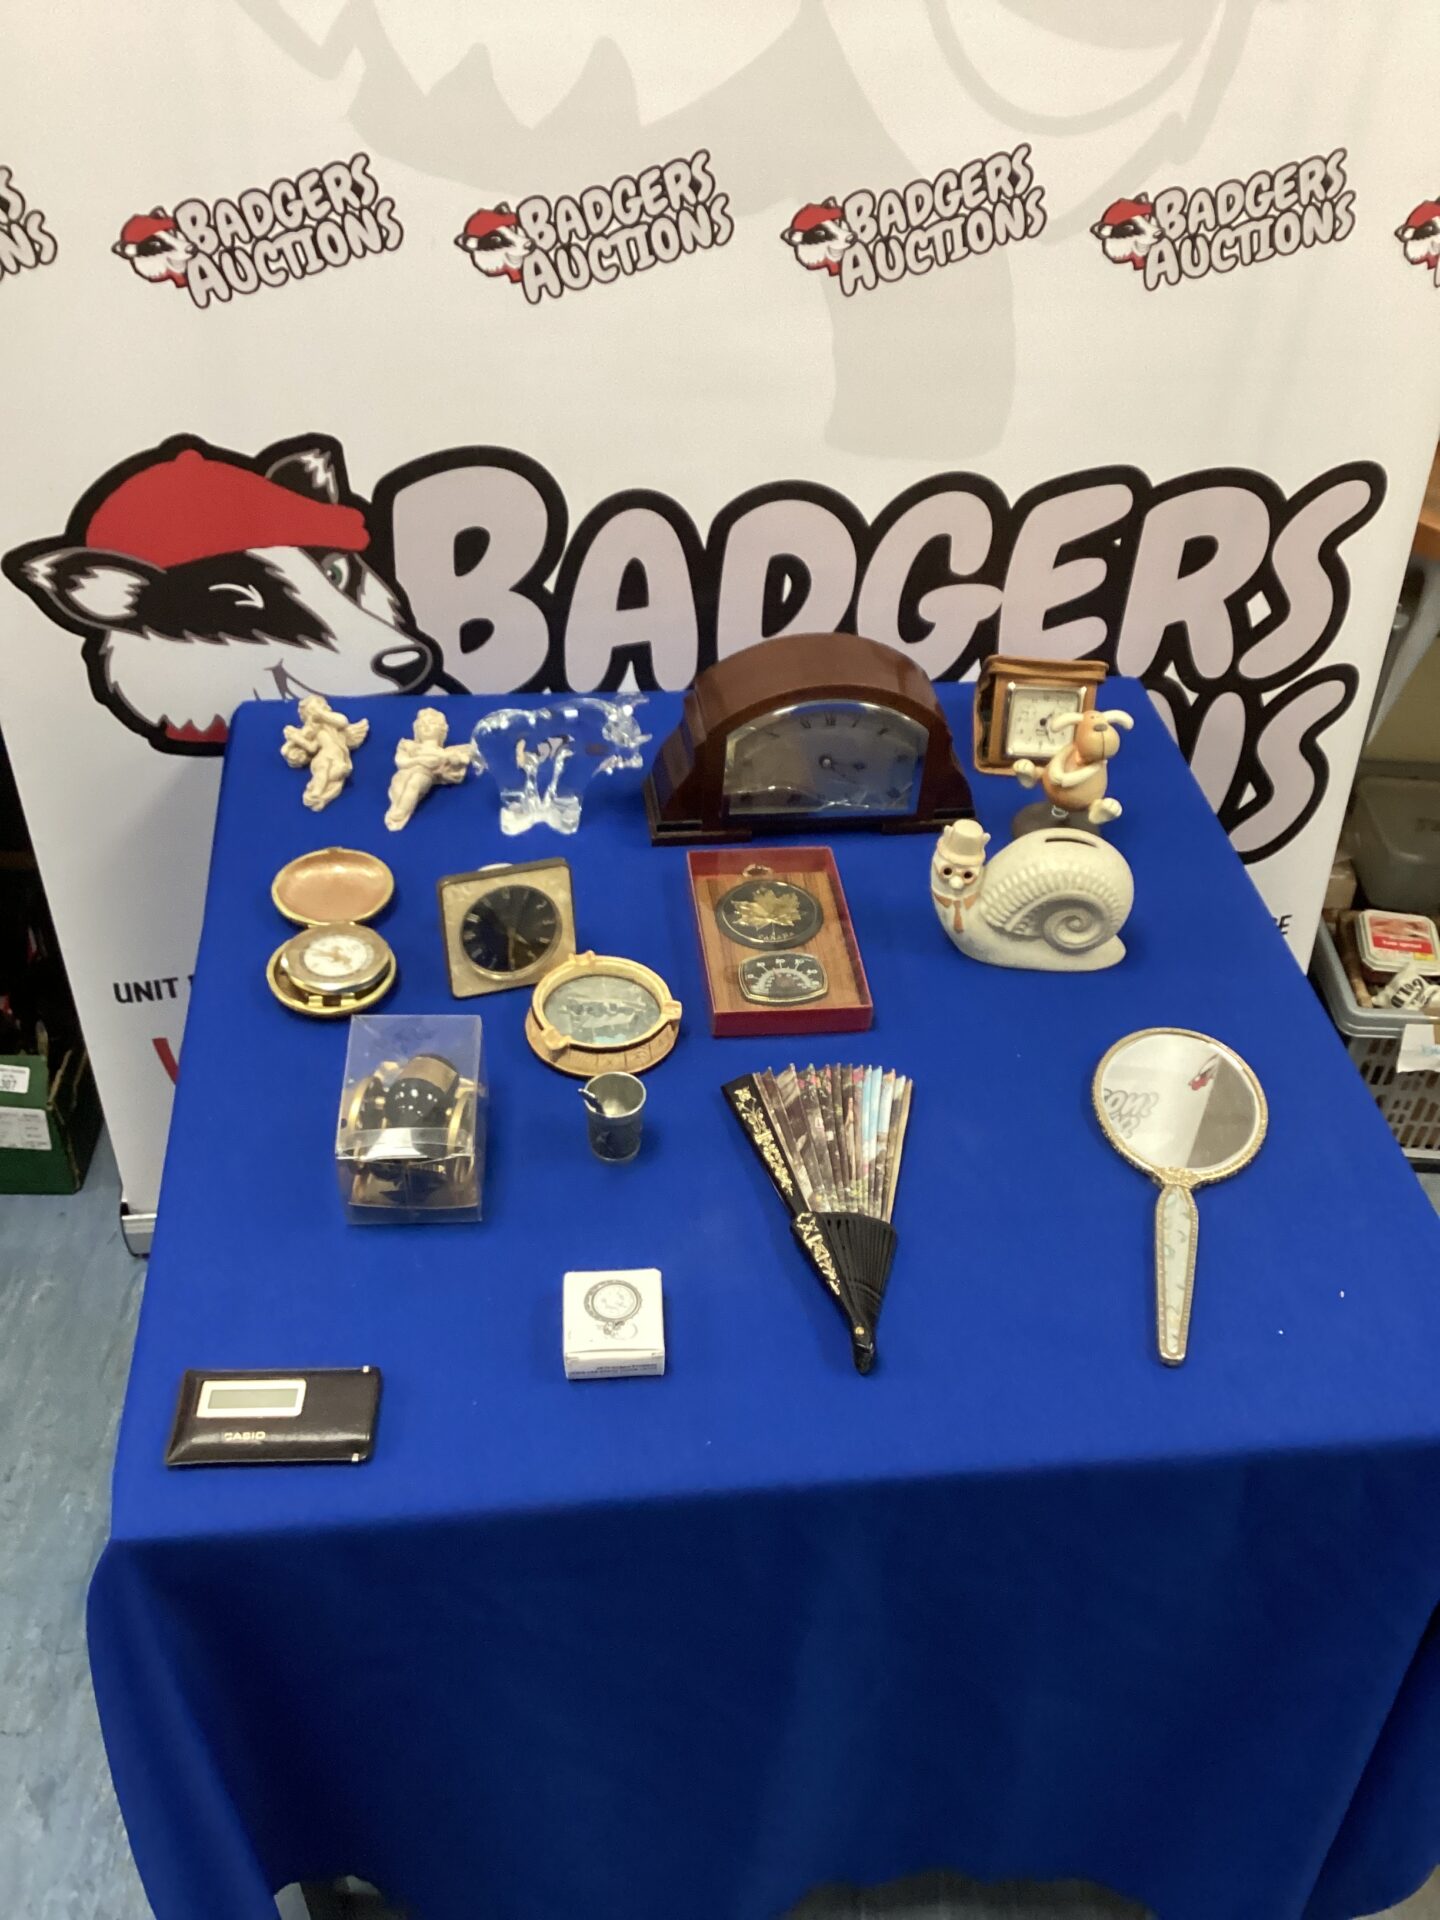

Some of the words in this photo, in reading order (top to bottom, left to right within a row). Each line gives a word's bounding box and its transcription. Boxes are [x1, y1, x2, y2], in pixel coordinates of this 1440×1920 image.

[174, 153, 378, 257] BADGERS
[516, 149, 716, 251] BADGERS
[840, 185, 1047, 296] AUCTIONS
[841, 143, 1034, 243] BADGERS
[1143, 190, 1357, 292] AUCTIONS
[1151, 148, 1348, 241] BADGERS
[186, 197, 404, 308] AUCTIONS
[522, 193, 733, 304] AUCTIONS
[376, 445, 1386, 694] BADGERS
[113, 976, 179, 1004] UNIT
[224, 1431, 266, 1442] CASIO
